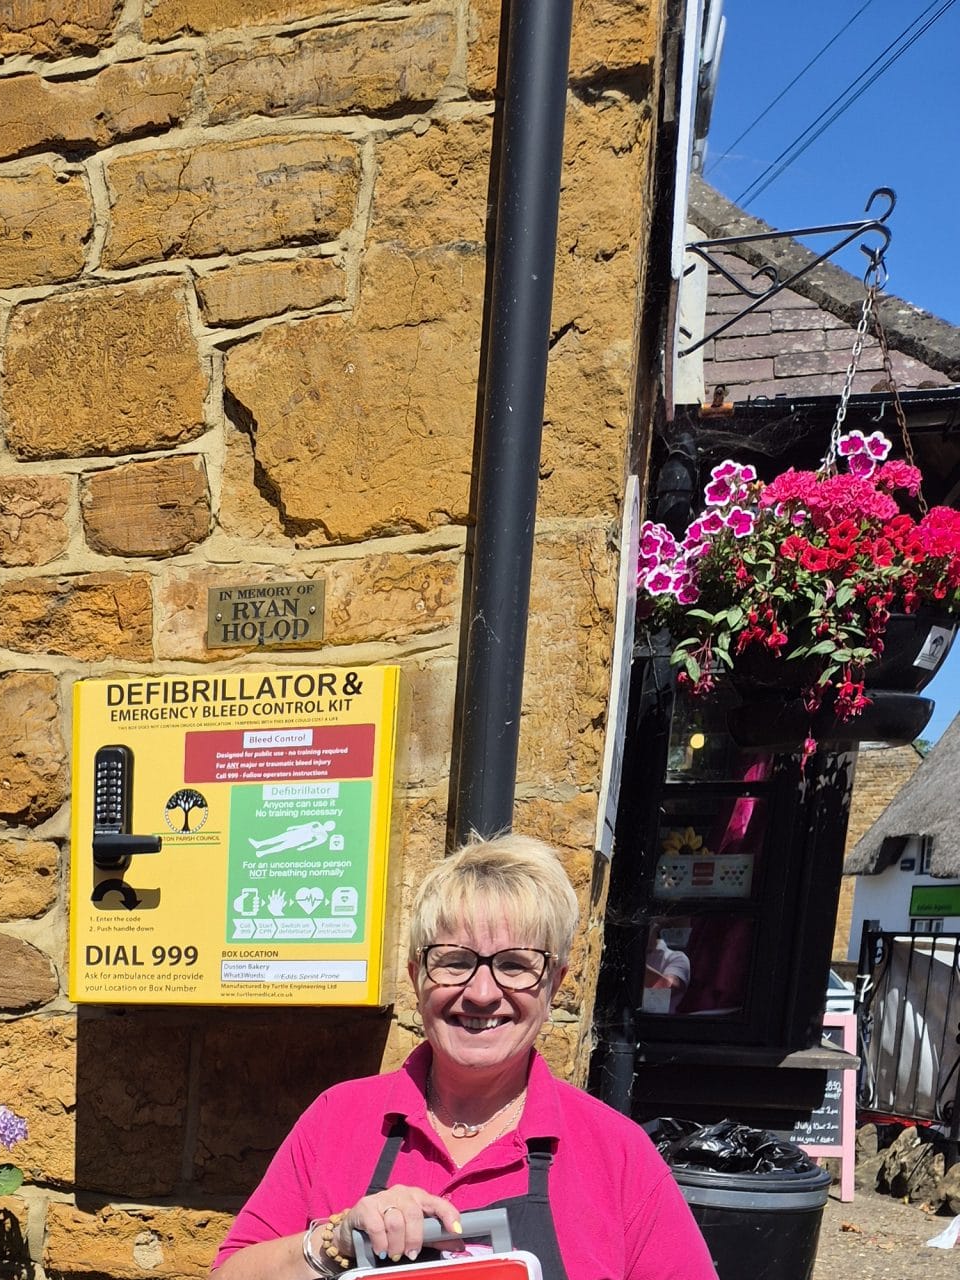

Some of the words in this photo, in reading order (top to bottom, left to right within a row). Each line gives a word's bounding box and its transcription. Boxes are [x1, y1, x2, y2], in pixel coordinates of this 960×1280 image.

[219, 590, 233, 601] IN
[237, 586, 293, 600] MEMORY
[296, 584, 315, 595] OF
[232, 598, 300, 620] RYAN
[221, 618, 310, 642] HOLOD
[107, 673, 337, 706] DEFIBRILLATOR
[342, 672, 363, 695] &
[110, 706, 198, 722] EMERGENCY
[202, 704, 249, 718] BLEED
[252, 700, 324, 716] CONTROL
[328, 699, 353, 712] KIT
[249, 735, 273, 744] Bleed
[274, 734, 306, 743] Control
[216, 751, 244, 759] Designed
[254, 750, 272, 758] public
[322, 747, 348, 755] required
[240, 762, 257, 770] major
[263, 771, 291, 779] operators
[292, 769, 328, 777] instructions
[271, 786, 331, 796] Defibrillator
[263, 800, 295, 810] Anyone
[329, 799, 336, 807] it
[255, 809, 267, 817] No
[268, 809, 299, 818] training
[300, 808, 343, 817] necessary
[242, 861, 257, 869] For
[270, 860, 322, 868] unconscious
[323, 860, 352, 869] person
[249, 869, 267, 878] NOT
[269, 868, 307, 878] breathing
[309, 868, 345, 878] normally
[85, 945, 145, 966] DIAL
[151, 945, 199, 966] 999
[240, 950, 279, 958] LOCATION
[85, 972, 98, 980] Ask
[100, 972, 111, 980] for
[112, 972, 155, 980] ambulance
[157, 972, 172, 980] and
[173, 973, 204, 983] provide
[104, 984, 137, 992] Location
